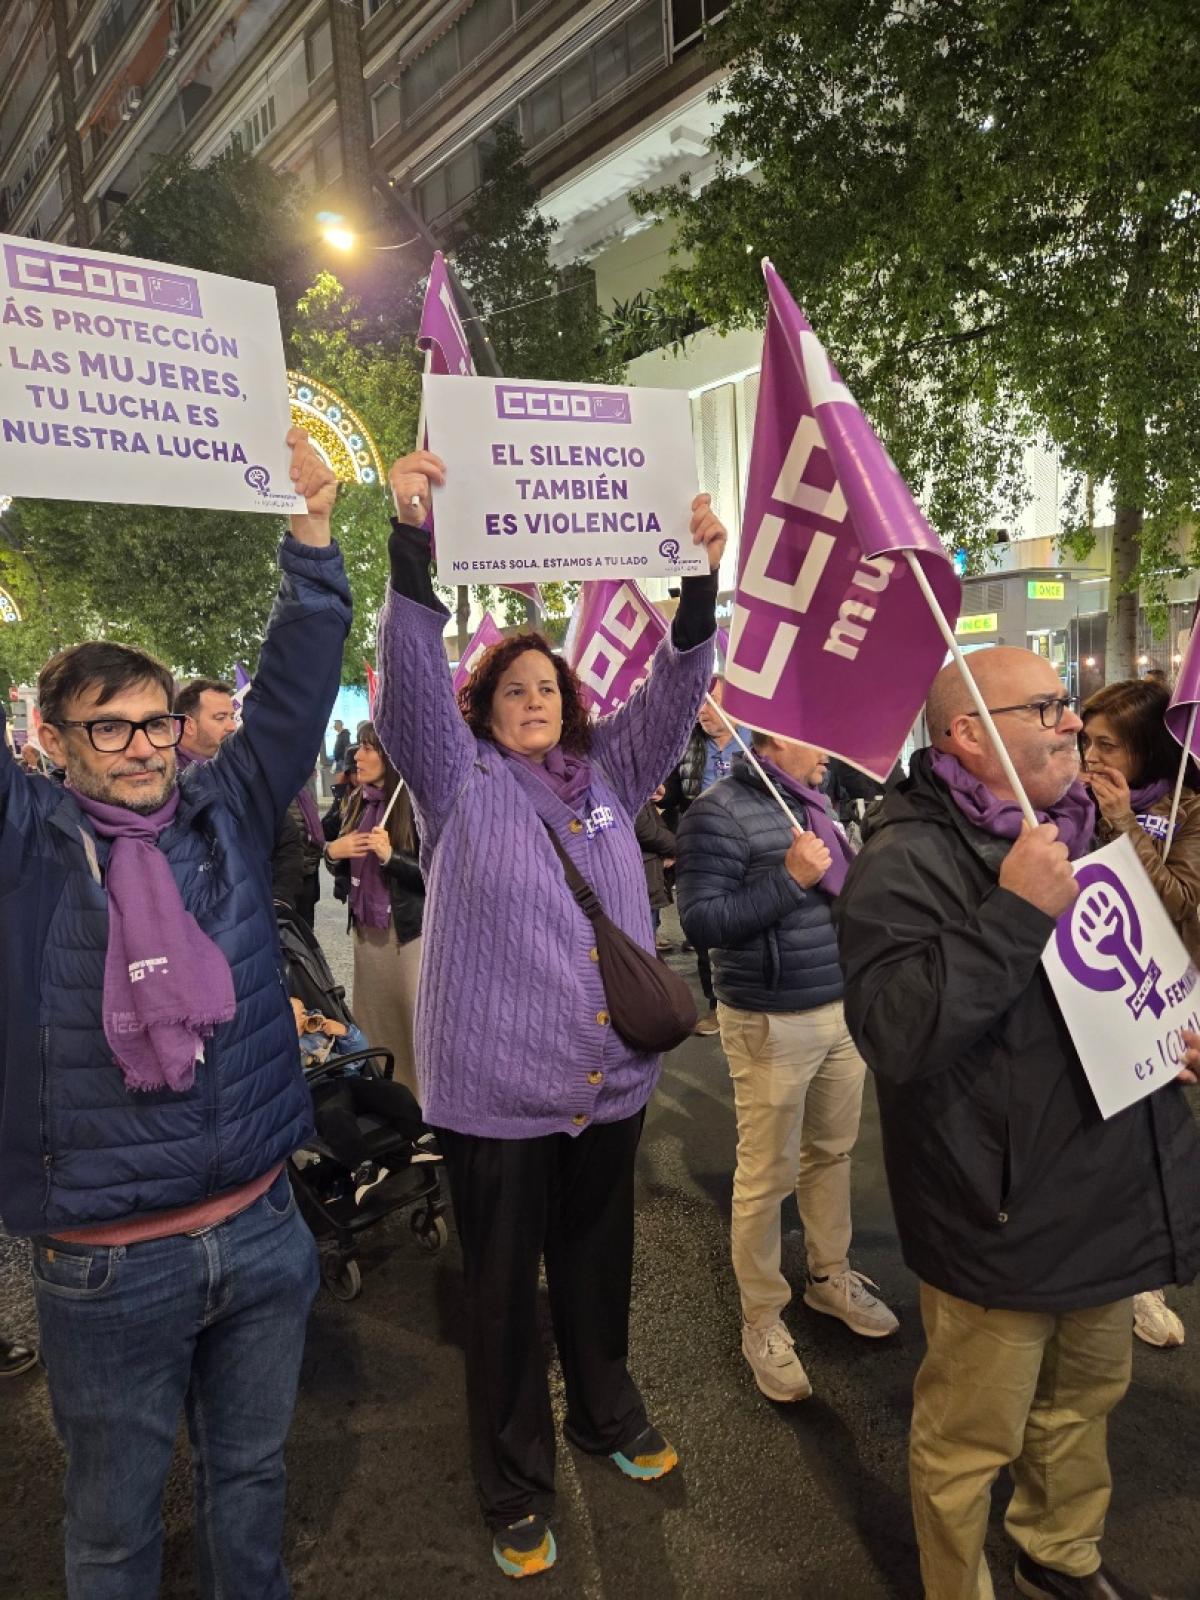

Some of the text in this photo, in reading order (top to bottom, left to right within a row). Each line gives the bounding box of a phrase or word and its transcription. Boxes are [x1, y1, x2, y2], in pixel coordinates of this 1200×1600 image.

[15, 254, 146, 302] CCOO
[52, 308, 239, 358] PROTECCIÓN
[9, 346, 247, 402] LAS MUJERES,
[25, 384, 220, 428] TU LUCHA ES
[502, 391, 591, 418] CCOO
[2, 418, 248, 464] NUESTRA LUCHA
[492, 443, 646, 468] EL SILENCIO
[515, 472, 628, 500] TAMBIÉN
[485, 511, 661, 536] ES VIOLENCIA
[452, 560, 470, 571] NO
[472, 559, 507, 570] ESTAS
[543, 557, 593, 569] ESTAMOS
[595, 557, 602, 567] A
[604, 556, 618, 567] TU
[620, 555, 648, 566] LADO
[1039, 585, 1062, 597] ONCE
[1134, 1057, 1154, 1081] es
